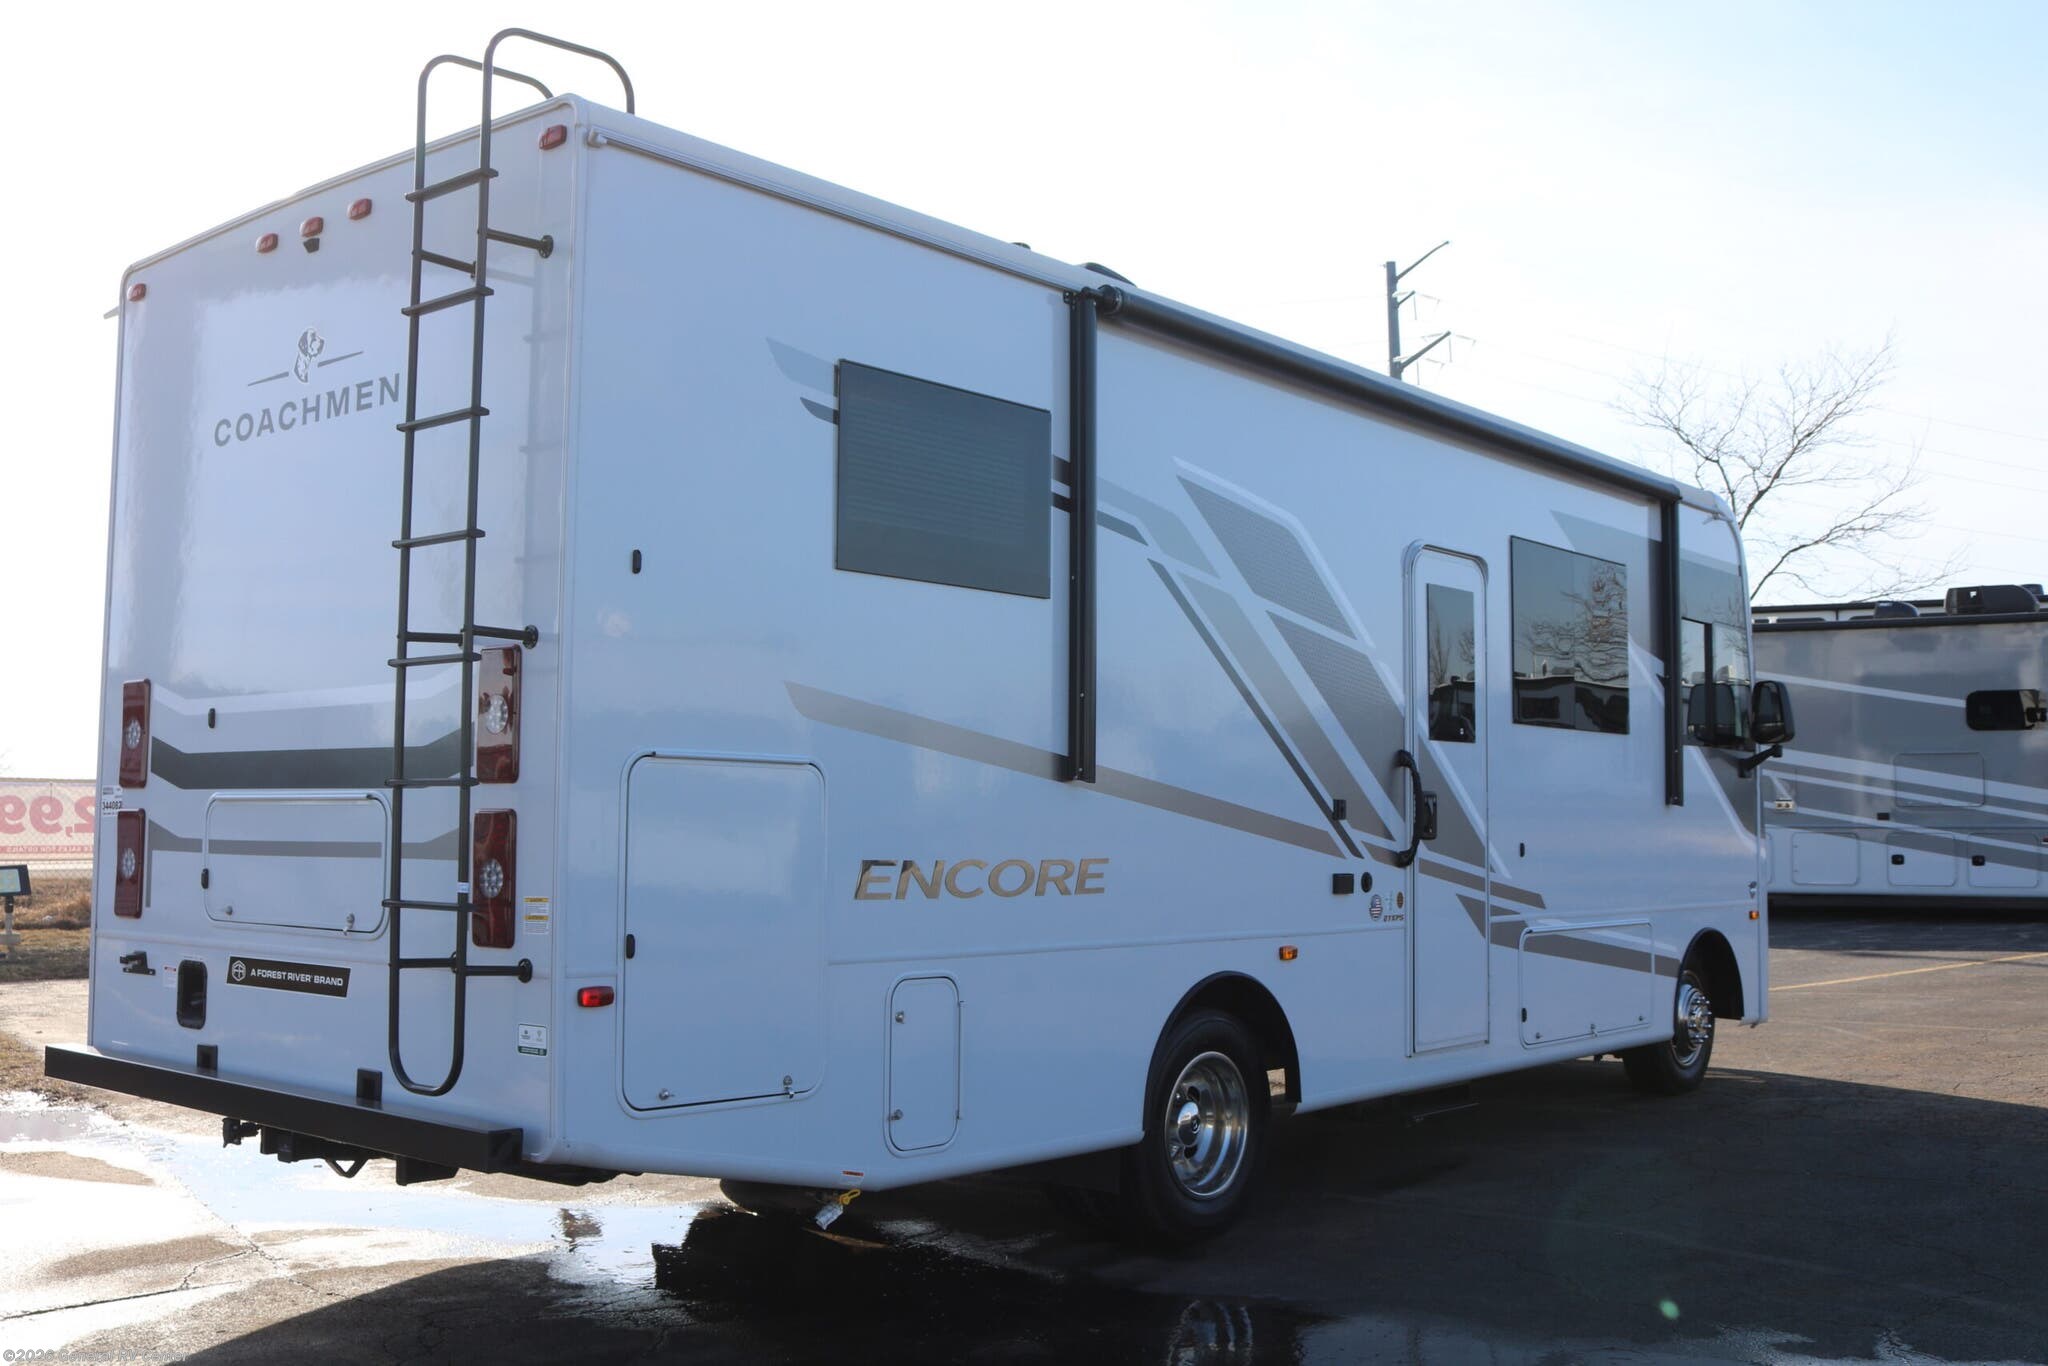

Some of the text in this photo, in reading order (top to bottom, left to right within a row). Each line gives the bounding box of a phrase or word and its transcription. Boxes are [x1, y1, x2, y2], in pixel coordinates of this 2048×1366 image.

[214, 373, 400, 447] COACHMEN
[854, 858, 1109, 900] ENCORE
[250, 968, 256, 976] A
[257, 969, 287, 980] FOREST
[314, 975, 344, 986] BRAND
